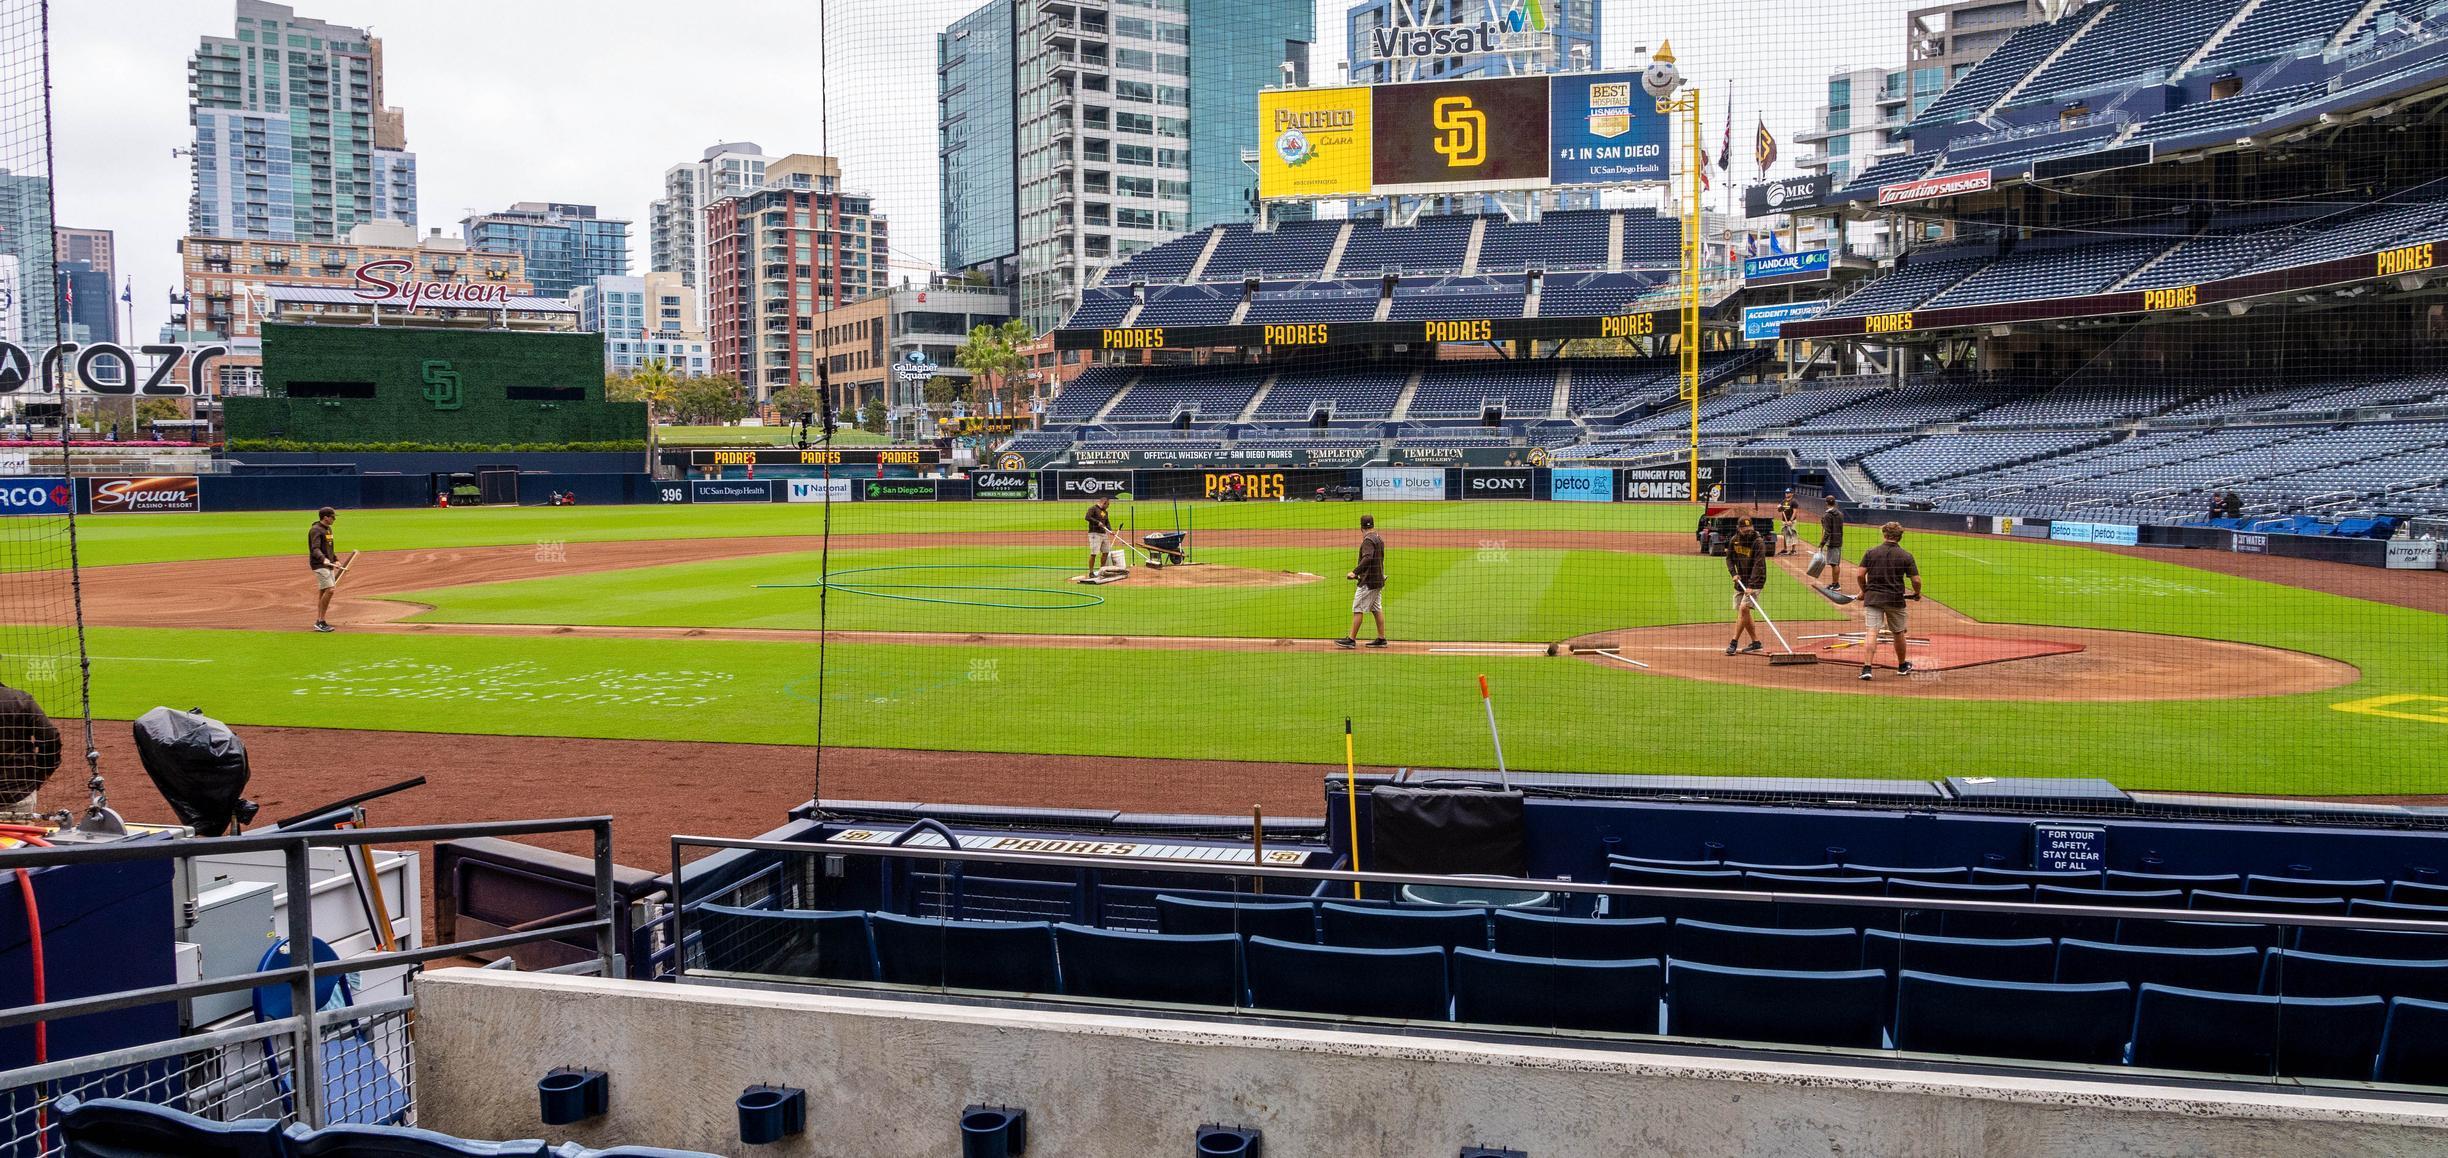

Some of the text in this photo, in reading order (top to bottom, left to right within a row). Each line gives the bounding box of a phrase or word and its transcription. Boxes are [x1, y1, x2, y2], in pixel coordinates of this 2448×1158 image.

[1374, 21, 1495, 57] Viasat
[1593, 85, 1627, 97] BEST
[1592, 98, 1628, 106] HOSPITALS
[1433, 96, 1486, 167] SD
[1561, 144, 1660, 160] #1 IN SAN DIEGO
[1590, 163, 1659, 176] UC San Diego Health
[1786, 183, 1814, 198] MRC
[1881, 177, 1988, 203] Tarantino SAUSAGES
[1758, 256, 1799, 270] LANDCARE
[2378, 243, 2433, 276] PADRES
[353, 259, 513, 313] Sycuan
[2144, 285, 2196, 311] PADRES
[1865, 312, 1912, 333] PADRES
[1103, 313, 1653, 349] PADRES PADRES PADRES PADRES
[41, 341, 228, 395] razr
[893, 363, 938, 373] Gallagher
[899, 371, 932, 380] Square
[714, 452, 756, 464] PADRES
[881, 451, 919, 463] PADRES
[1074, 451, 1130, 460] TEMPLETON
[1144, 451, 1176, 460] OFFICIAL
[1178, 451, 1213, 459] WHISKEY
[1230, 450, 1244, 458] SAN
[1245, 450, 1265, 458] DIEGO
[1266, 450, 1293, 458] PADRES
[1306, 449, 1365, 459] TEMPLETON
[1403, 449, 1463, 458] TEMPLETON
[977, 473, 1024, 487] Chosen
[1632, 470, 1686, 480] HUNGRY FOR
[811, 484, 847, 492] Natonal
[1065, 477, 1125, 494] EVOTEK
[1205, 473, 1284, 498] PARES
[1366, 477, 1430, 487] blue blue
[1472, 478, 1526, 489] SONY
[1555, 475, 1590, 493] petco
[98, 480, 190, 510] Sycuan
[661, 488, 682, 502] 396
[724, 487, 739, 496] Diego
[897, 486, 917, 496] Diego
[1628, 482, 1690, 499] HOMERS
[2053, 525, 2071, 536] petco
[2094, 528, 2115, 540] petco
[2048, 831, 2094, 840] FOR YOUR
[992, 838, 1136, 855] PADRES
[2042, 851, 2099, 860] STAY CLEAR
[2054, 861, 2086, 870] OF ALL
